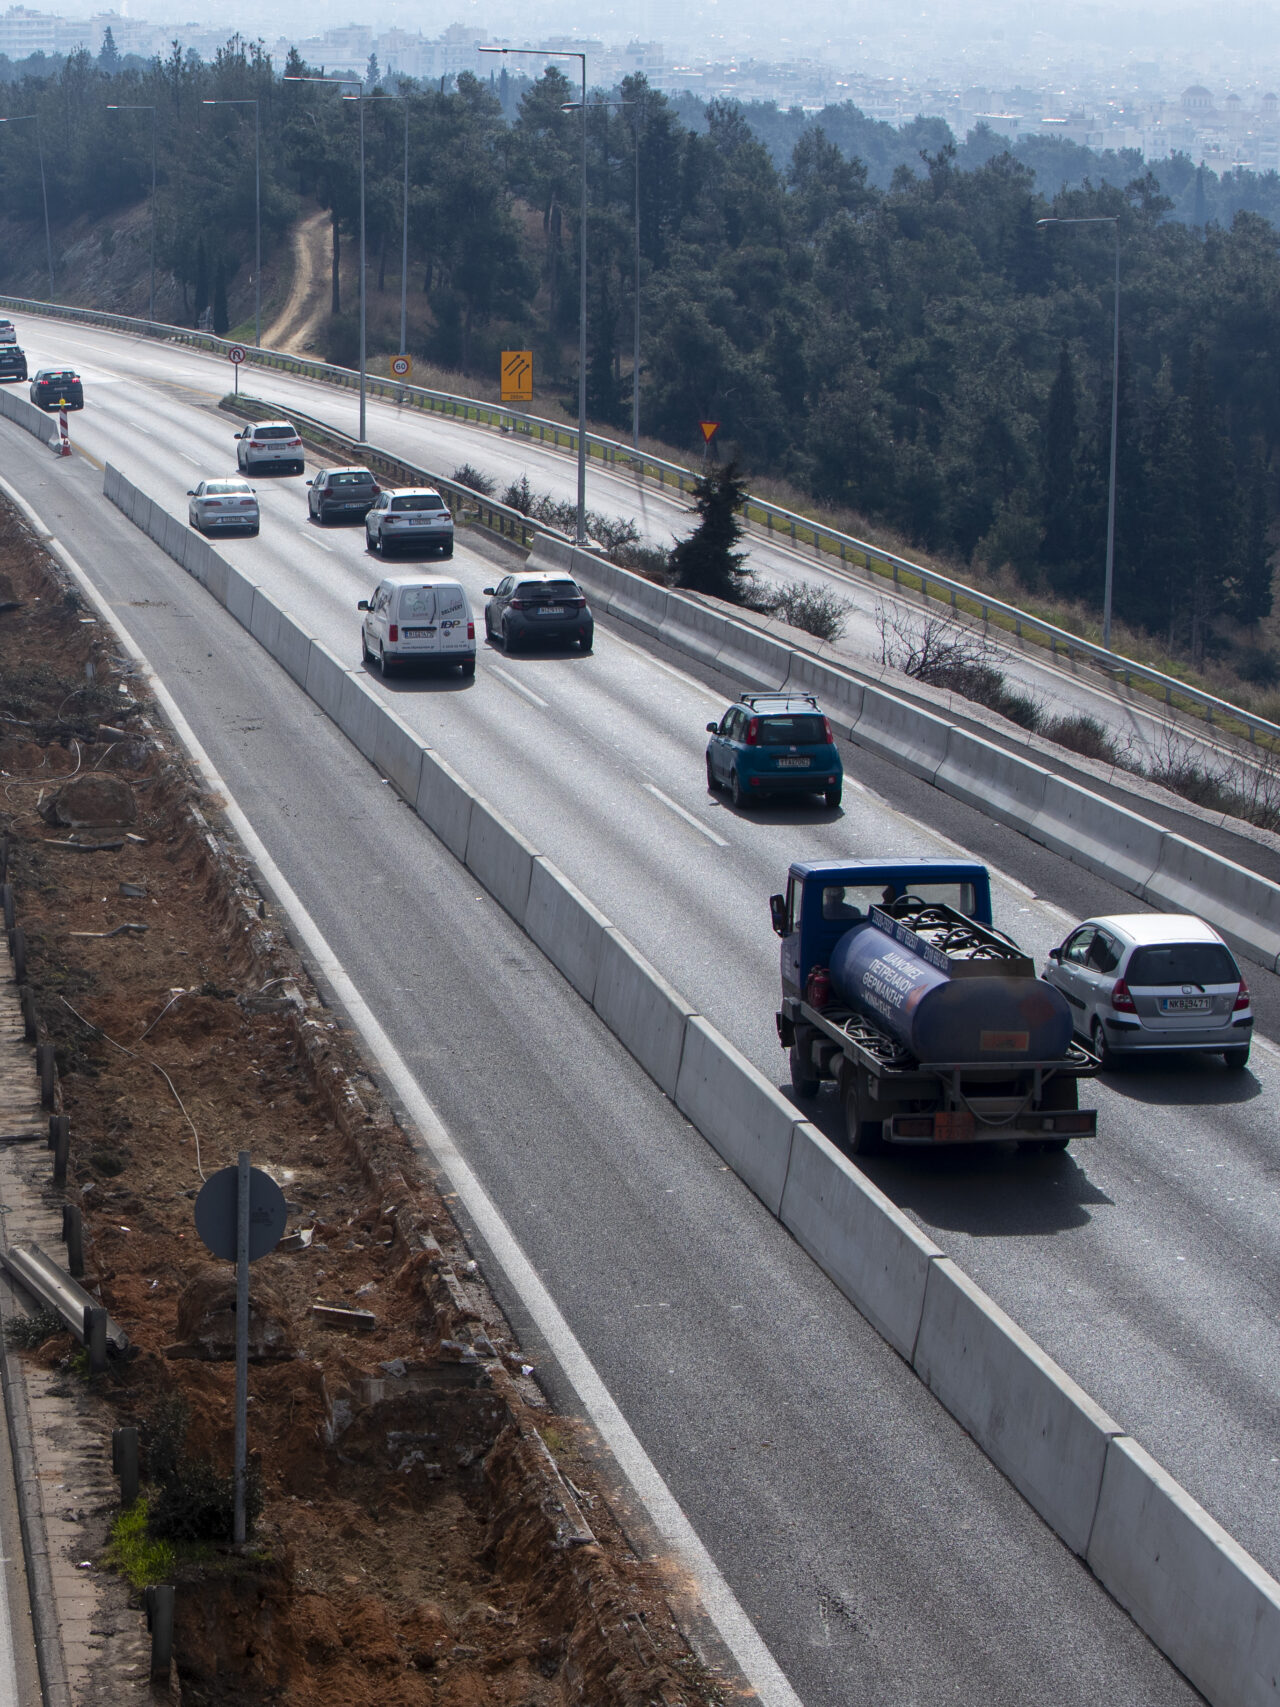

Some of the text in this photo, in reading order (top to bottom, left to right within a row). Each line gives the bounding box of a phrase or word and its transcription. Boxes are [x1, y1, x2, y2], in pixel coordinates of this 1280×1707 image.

[868, 959, 915, 994] ΠΕΤΡΕΛΑΙΟΥ
[882, 952, 925, 980] ΔΙΑΝΟΜΕΣ
[862, 972, 904, 1009] ΘΕΡΜΑΝΣΗΣ
